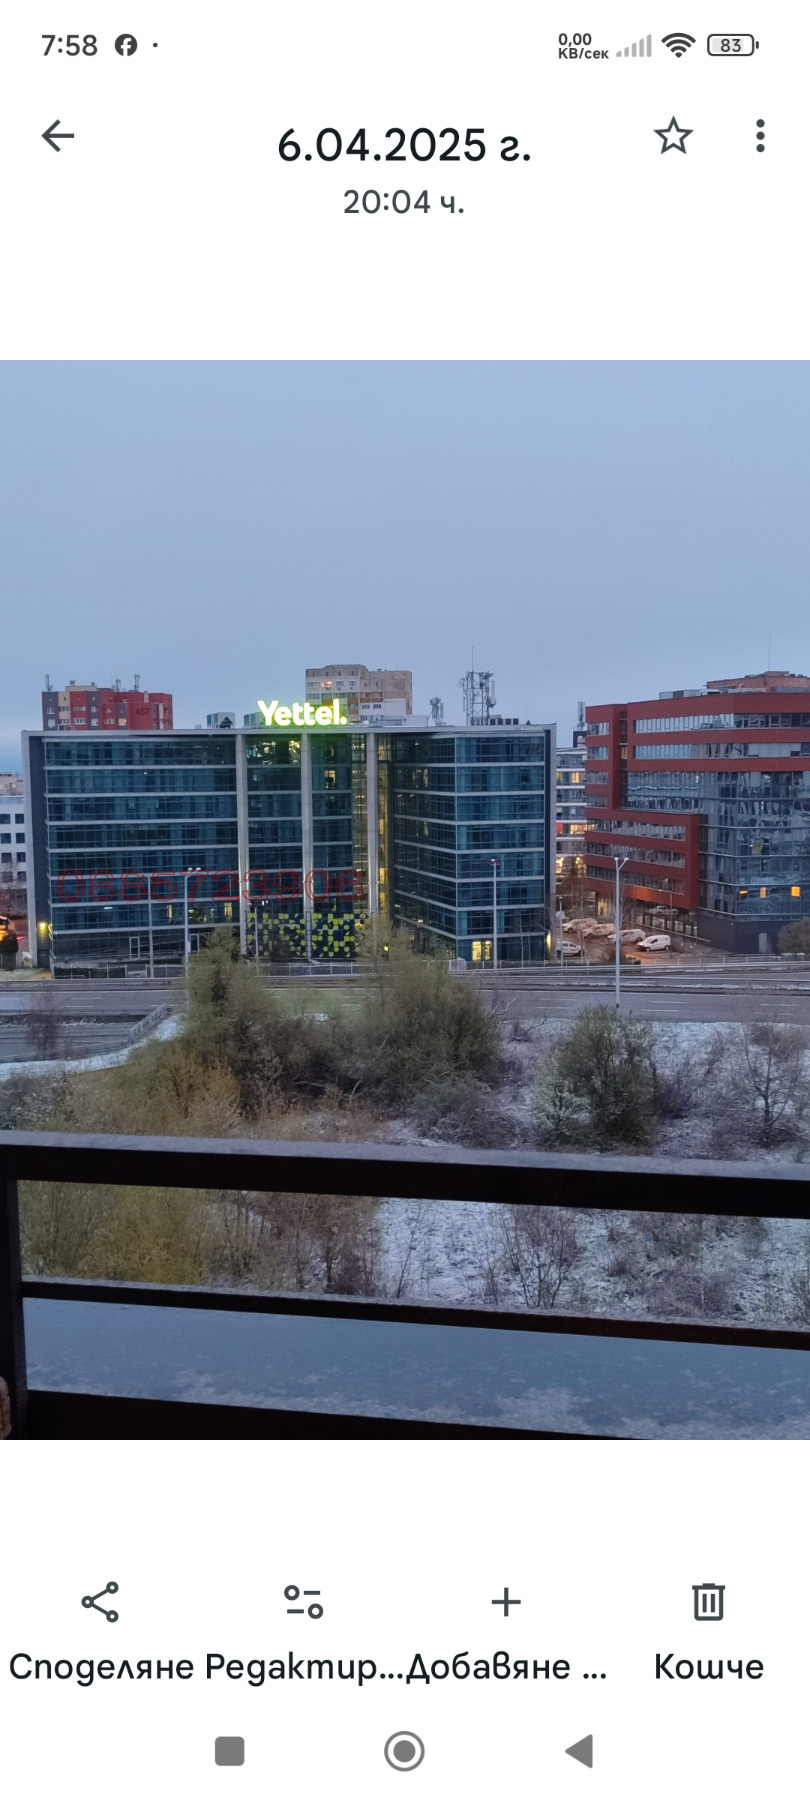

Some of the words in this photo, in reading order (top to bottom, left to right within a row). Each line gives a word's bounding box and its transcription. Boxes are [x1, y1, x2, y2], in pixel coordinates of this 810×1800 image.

[41, 34, 98, 57] 7:58
[558, 33, 592, 47] 0,00
[558, 47, 609, 60] KB/сек
[720, 38, 742, 53] 83
[278, 127, 486, 162] 6.04.2025
[500, 135, 531, 162] г.
[343, 189, 431, 215] 20:04
[440, 195, 464, 214] ч.
[257, 698, 348, 726] Yettel.
[9, 1652, 194, 1688] Споделяне
[206, 1650, 404, 1688] Редактир...
[405, 1650, 571, 1685] Добавяне
[655, 1653, 764, 1680] Кошче
